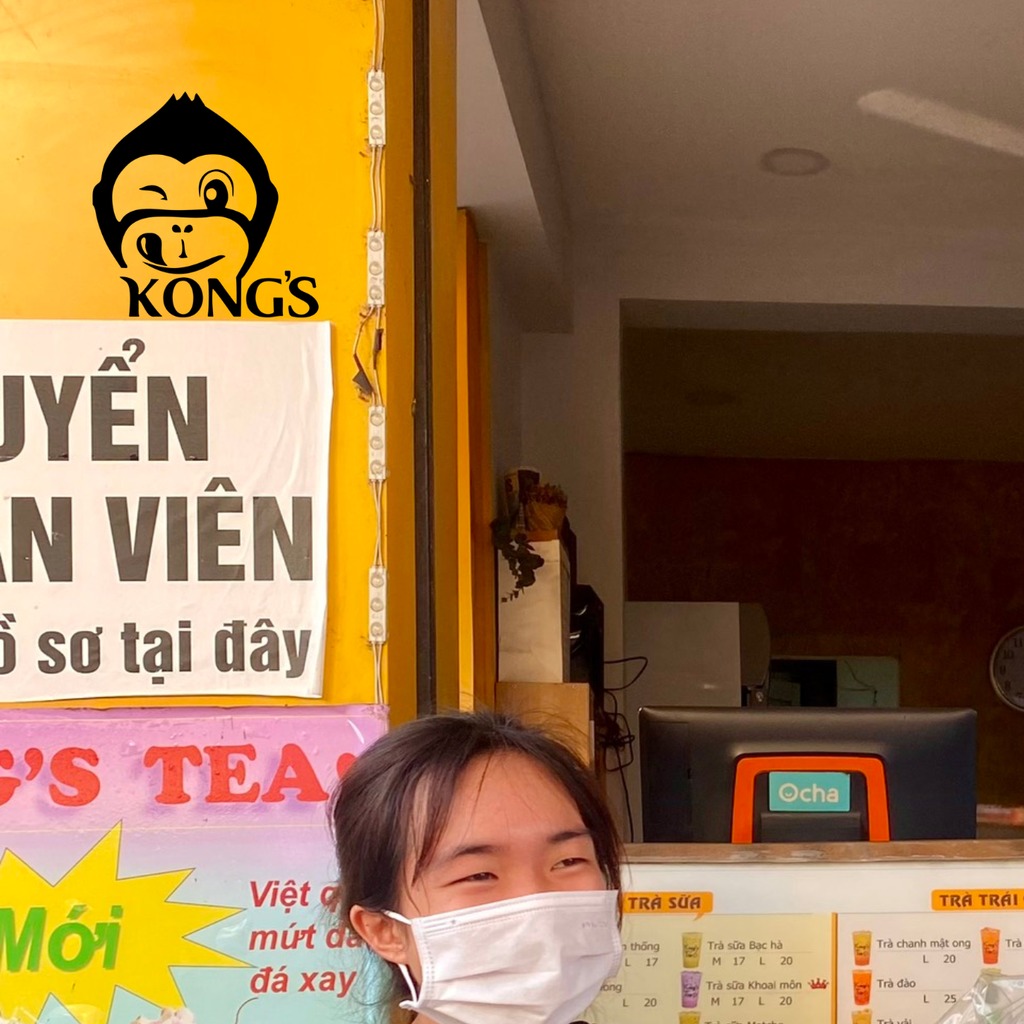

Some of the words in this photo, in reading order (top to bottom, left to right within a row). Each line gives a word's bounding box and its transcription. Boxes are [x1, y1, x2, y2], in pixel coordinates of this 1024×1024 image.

[105, 477, 313, 581] VIÊN
[38, 626, 104, 674] sơ
[121, 620, 192, 685] tại
[214, 618, 312, 679] đây
[778, 782, 839, 804] Ocha
[250, 880, 311, 913] Việt
[628, 895, 662, 910] TRÀ
[669, 894, 701, 910] SỮA
[939, 891, 973, 907] TRÀ
[979, 891, 1018, 906] TRÁI
[0, 904, 124, 974] Mới
[250, 926, 317, 950] mứt
[1005, 937, 1022, 948] Trà
[707, 940, 725, 950] Trà
[727, 941, 746, 950] sữa
[749, 940, 768, 951] Bạc
[770, 940, 783, 950] hà
[877, 938, 894, 948] Trà
[896, 938, 926, 948] chanh
[930, 938, 950, 949] mật
[952, 941, 971, 950] ong
[625, 958, 631, 967] L
[646, 958, 658, 967] 17
[712, 957, 721, 966] M
[733, 957, 745, 966] 17
[759, 957, 766, 966] L
[780, 957, 793, 966] 20
[923, 955, 929, 963] L
[943, 955, 956, 964] 20
[250, 967, 289, 994] đá
[299, 970, 357, 999] xay
[707, 980, 724, 990] Trà
[726, 980, 745, 990] sữa
[748, 980, 776, 990] Khoai
[779, 980, 802, 990] môn
[877, 978, 894, 988] Trà
[897, 978, 916, 988] đào
[622, 998, 629, 1007] L
[644, 998, 657, 1007] 20
[711, 997, 720, 1006] M
[732, 997, 744, 1006] 17
[758, 997, 765, 1006] L
[779, 997, 792, 1006] 20
[923, 995, 929, 1003] L
[944, 995, 957, 1003] 25
